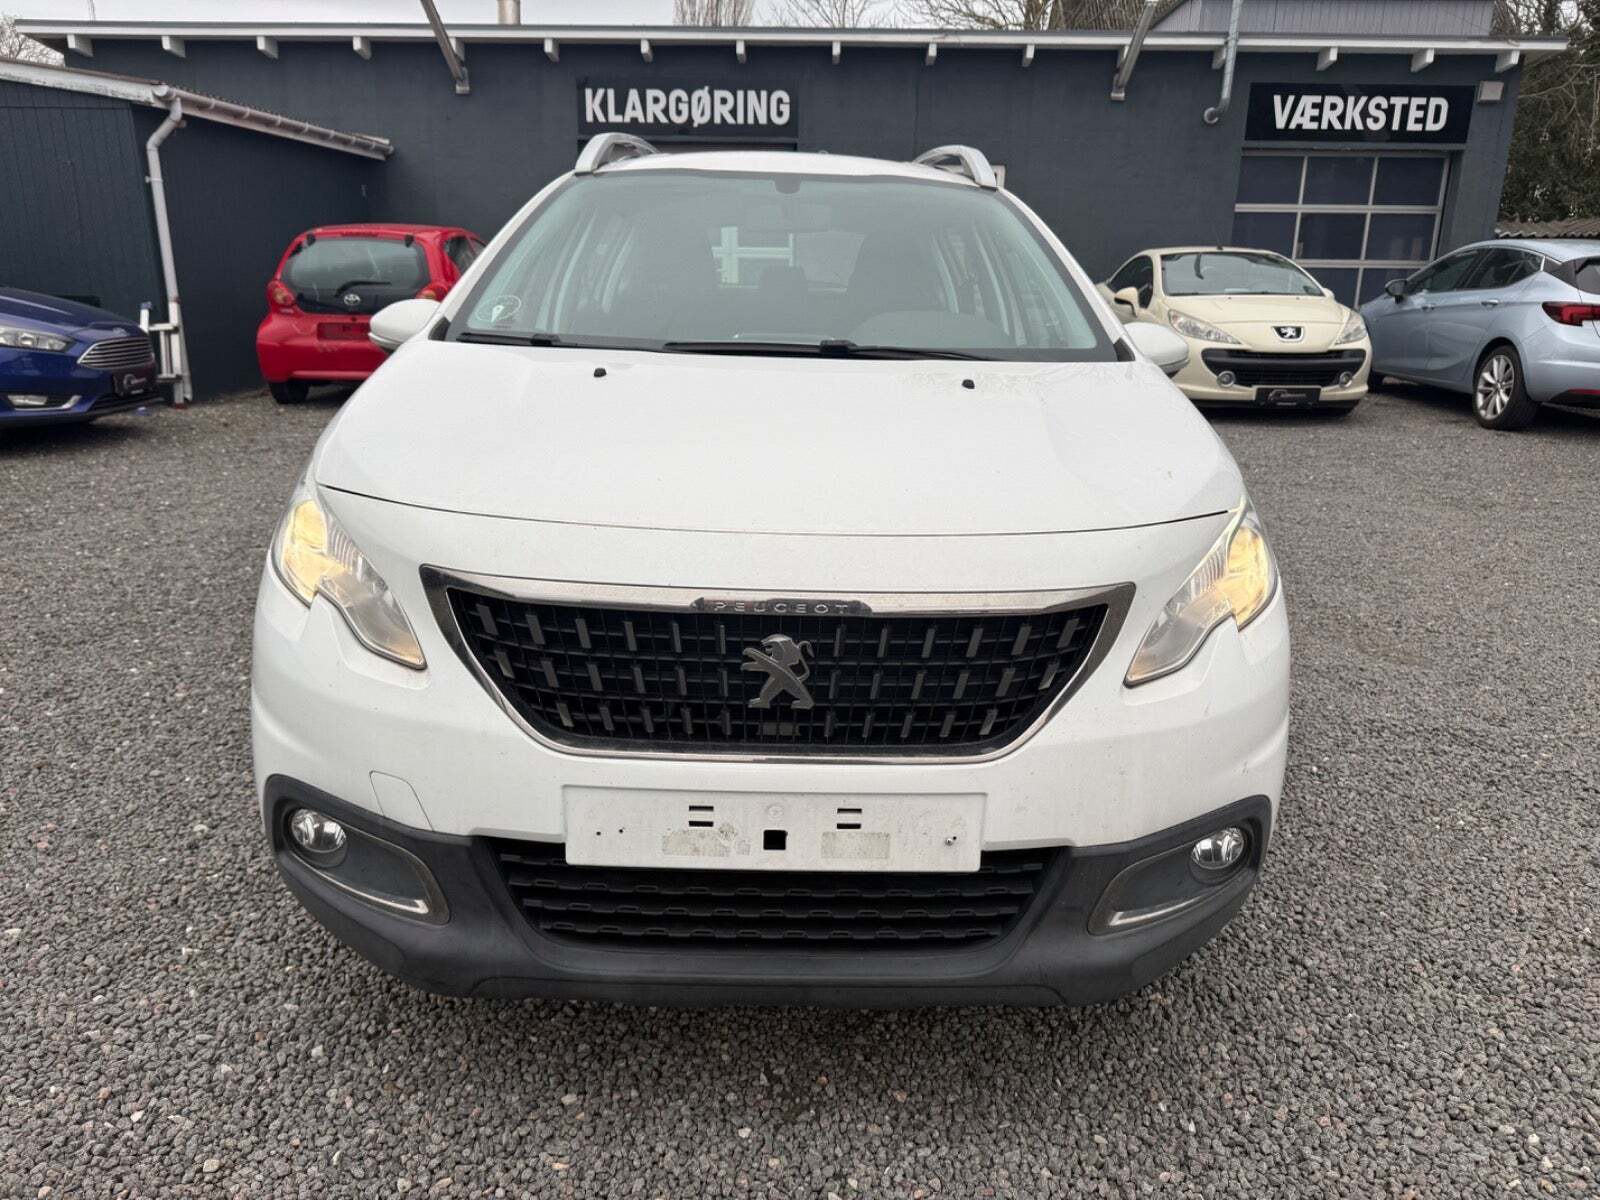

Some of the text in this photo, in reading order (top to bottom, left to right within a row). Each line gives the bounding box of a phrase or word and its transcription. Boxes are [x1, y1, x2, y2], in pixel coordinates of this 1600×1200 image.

[584, 86, 791, 127] KLARGØRING
[1273, 94, 1450, 131] VÆRKSTED
[713, 601, 849, 614] PEUGEOT
